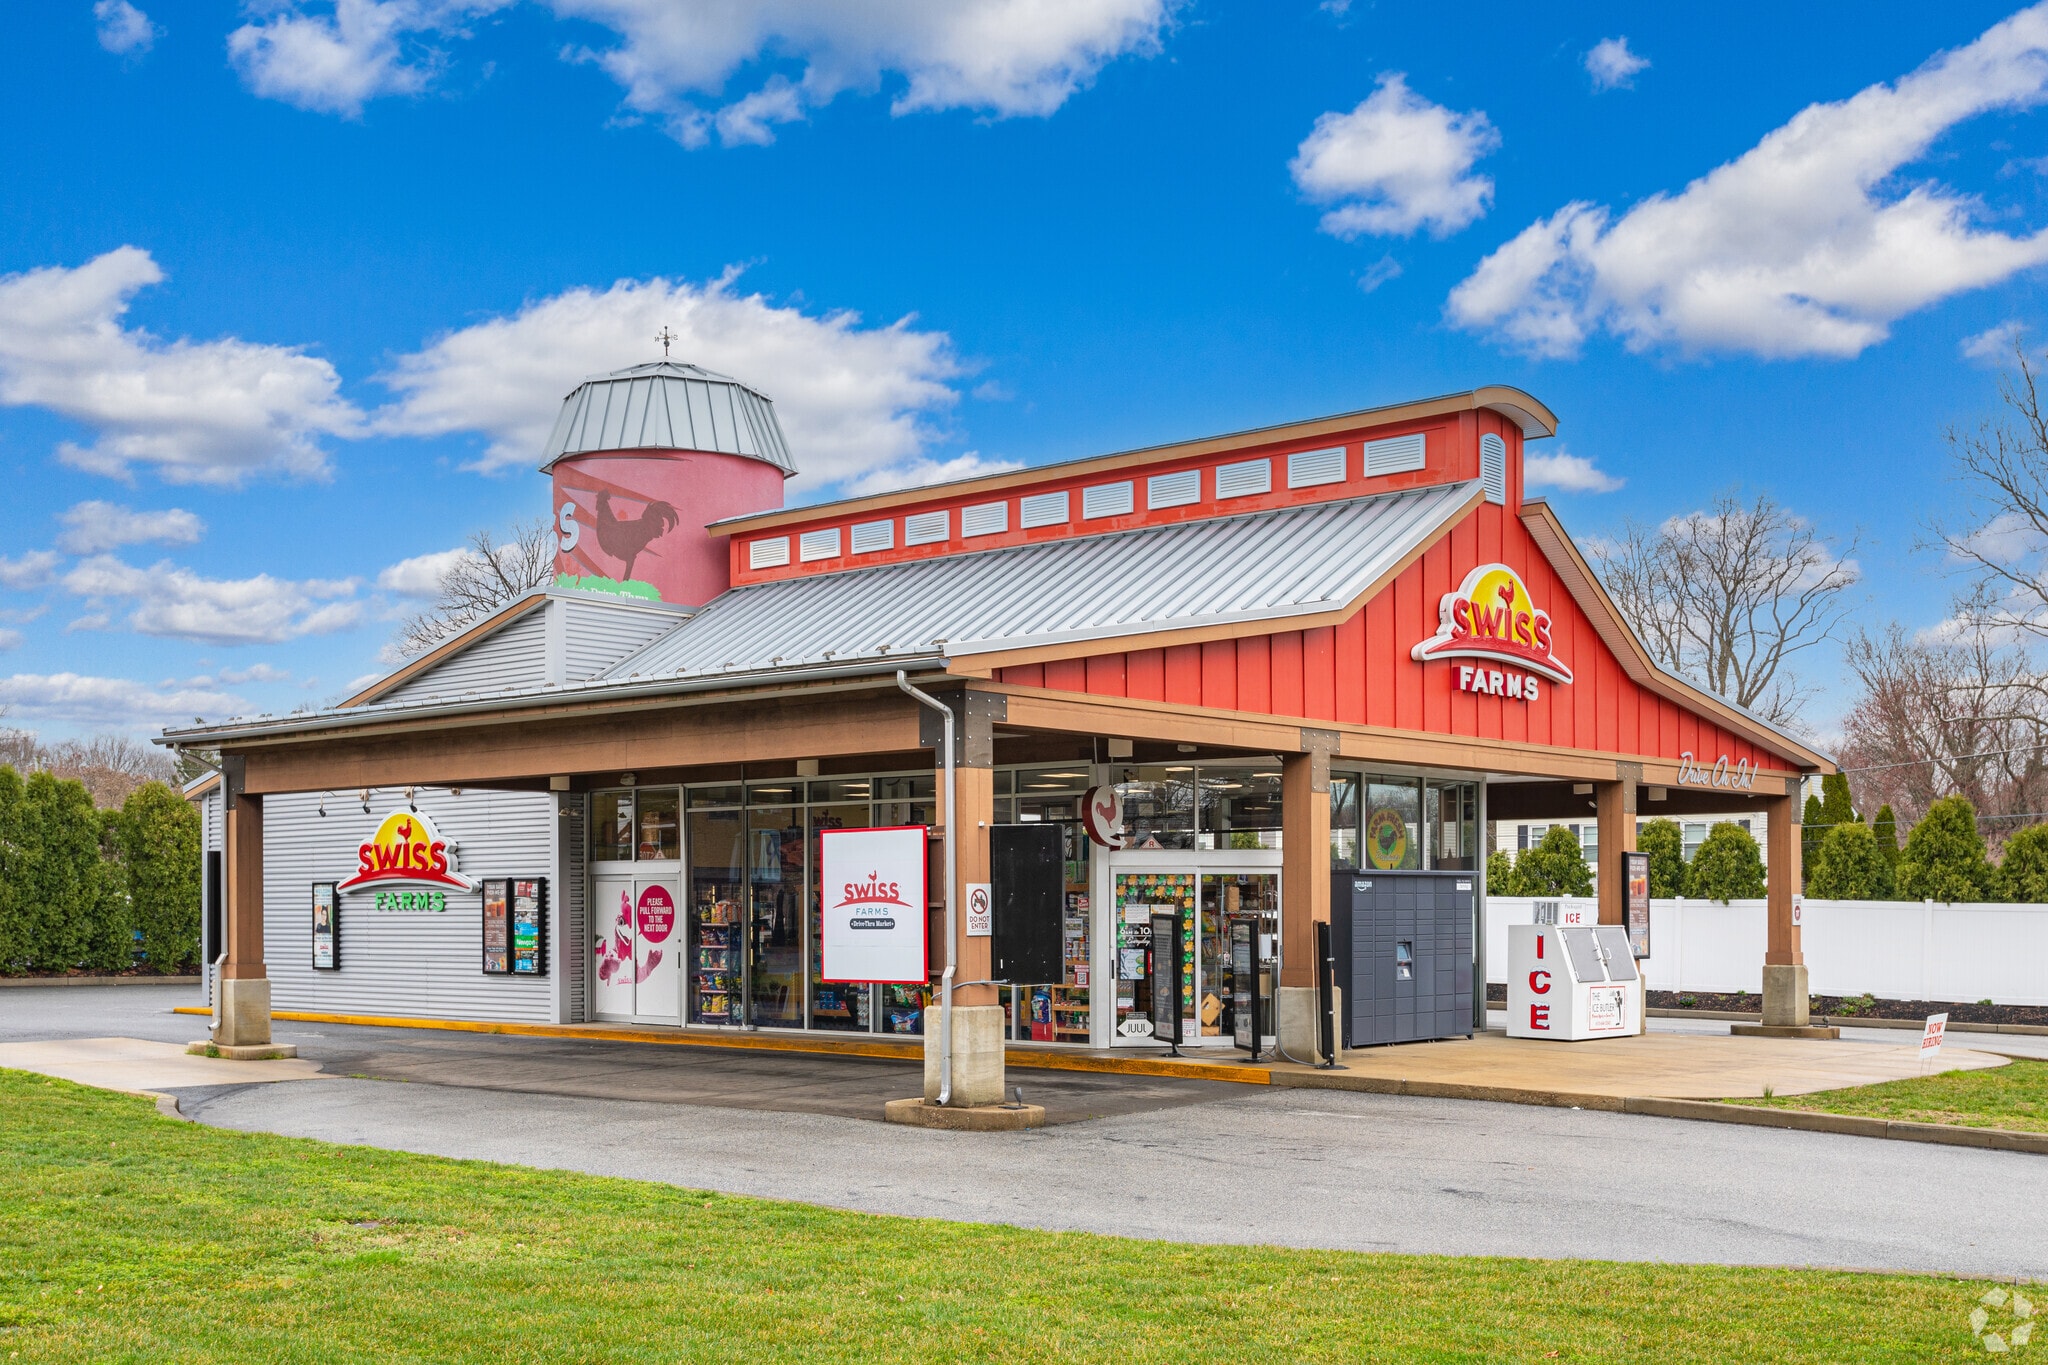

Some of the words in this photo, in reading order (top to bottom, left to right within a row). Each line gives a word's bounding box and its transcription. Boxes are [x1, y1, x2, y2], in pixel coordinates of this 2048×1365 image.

[1451, 598, 1551, 659] SWISS
[1457, 665, 1539, 701] FARMS
[1678, 751, 1710, 785] Drive
[1711, 754, 1730, 788] On
[1731, 757, 1758, 790] In!
[358, 840, 448, 876] SWISS
[844, 882, 900, 901] SWISS
[374, 891, 447, 912] FARMS
[647, 897, 663, 906] PLEASE
[640, 906, 650, 915] PULL
[651, 906, 672, 915] FORWARD
[855, 907, 889, 916] FARMS
[648, 915, 654, 924] TO
[655, 915, 663, 924] THE
[1565, 913, 1581, 924] ICE
[644, 924, 655, 932] NEXT
[655, 924, 668, 932] DOOR
[1127, 936, 1151, 947] Everyday
[1127, 1023, 1147, 1033] JUUL
[1927, 1022, 1943, 1035] NOW
[1922, 1035, 1942, 1049] HIRING
